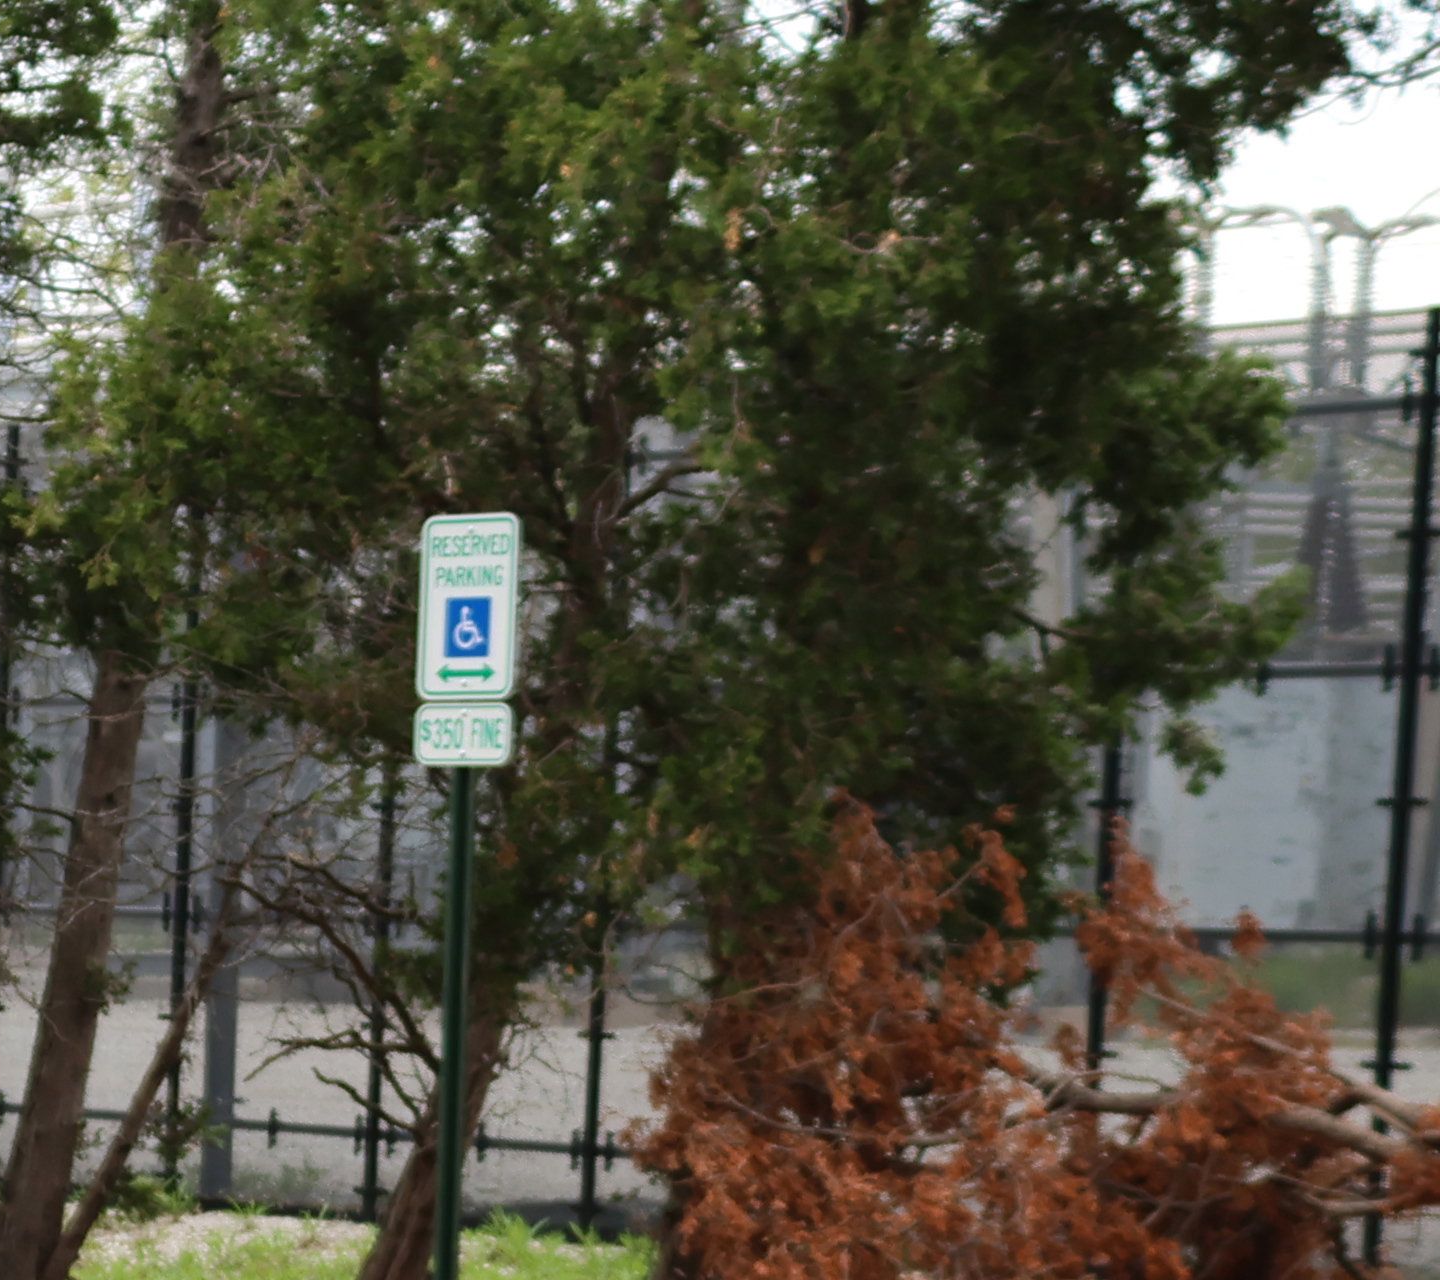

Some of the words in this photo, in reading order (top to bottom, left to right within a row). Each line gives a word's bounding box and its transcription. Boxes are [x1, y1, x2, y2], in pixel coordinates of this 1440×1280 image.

[431, 533, 512, 557] RESERVED
[435, 564, 504, 587] PARKING
[420, 718, 463, 750] $350
[470, 717, 505, 750] FINE
